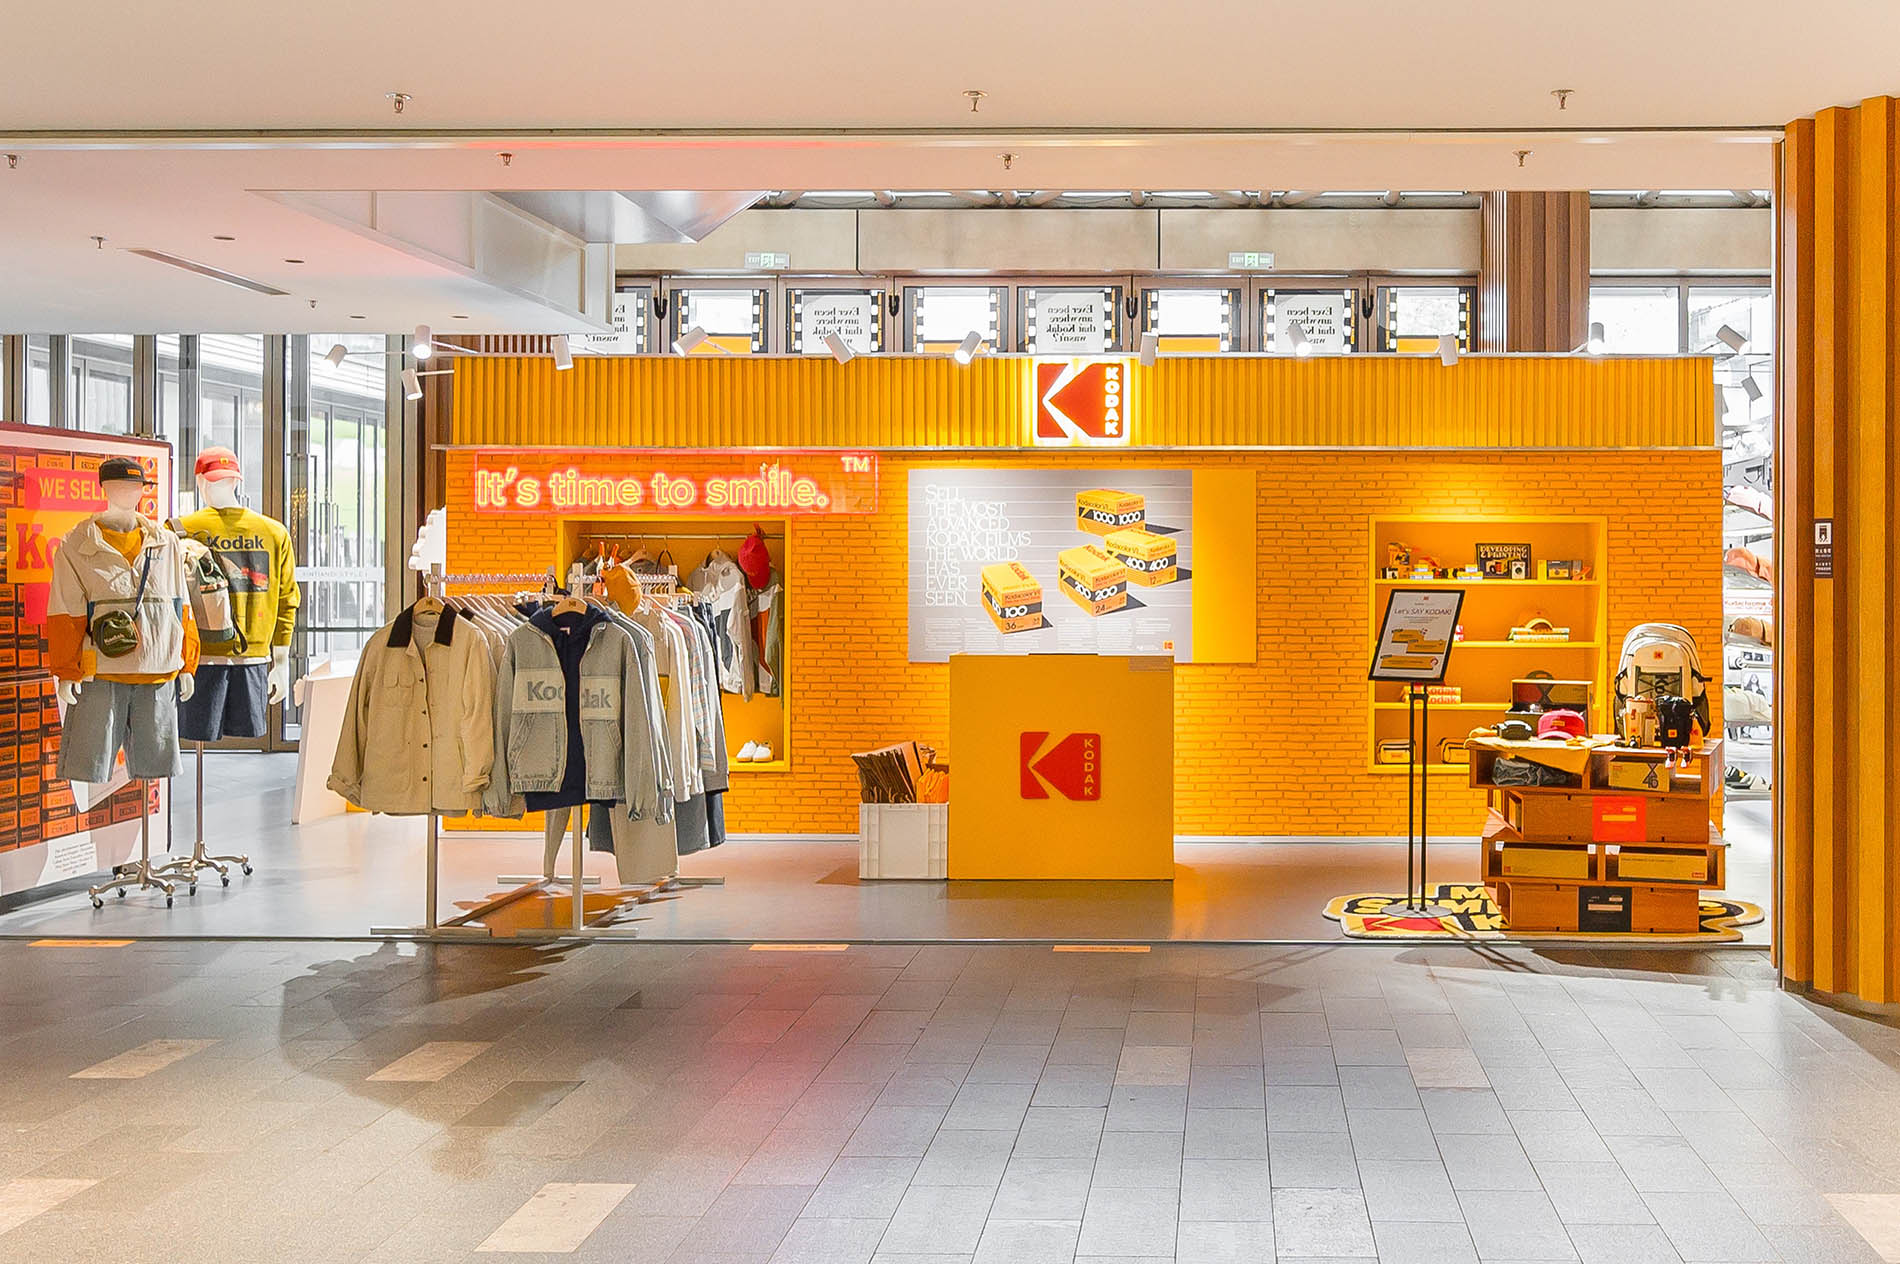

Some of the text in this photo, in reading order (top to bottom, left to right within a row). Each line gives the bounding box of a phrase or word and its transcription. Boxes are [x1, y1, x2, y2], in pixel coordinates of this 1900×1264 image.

[1105, 367, 1120, 435] KODAK
[39, 477, 66, 499] WE
[549, 470, 640, 506] time
[652, 471, 695, 506] to
[706, 470, 829, 507] smile.
[926, 502, 1006, 517] THE MOST
[927, 518, 1010, 531] ADVANCED
[1093, 510, 1115, 526] 1000
[1119, 511, 1141, 525] 1000
[927, 531, 1032, 545] KODAK FILMS
[926, 547, 1018, 560] THE WORLD
[926, 561, 960, 575] HAS
[1149, 557, 1168, 571] 400
[926, 576, 968, 590] EVER
[1074, 581, 1091, 600] 200
[1095, 585, 1118, 601] 200
[925, 591, 968, 606] SEEN
[1005, 605, 1028, 618] 100
[1005, 622, 1016, 630] 36
[1083, 738, 1095, 796] KODAK
